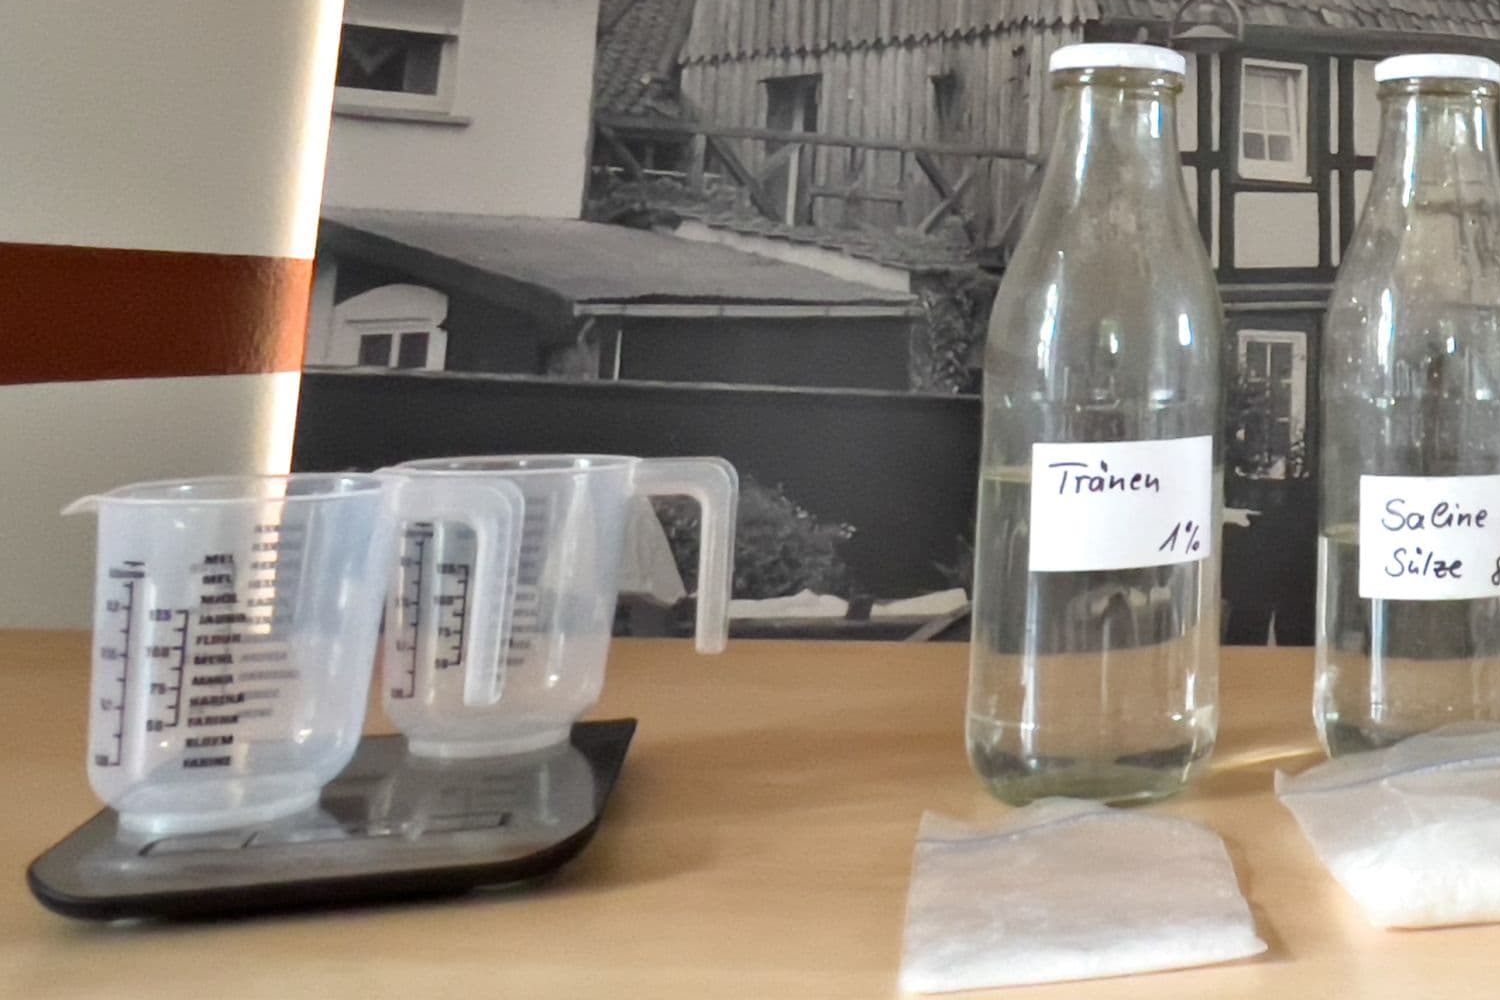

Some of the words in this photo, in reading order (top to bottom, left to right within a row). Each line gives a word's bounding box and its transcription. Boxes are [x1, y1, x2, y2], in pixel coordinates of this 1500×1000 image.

[1049, 460, 1161, 496] Tränen
[1381, 498, 1488, 532] Saline
[1159, 521, 1201, 554] 1%
[1385, 547, 1463, 580] Sülze
